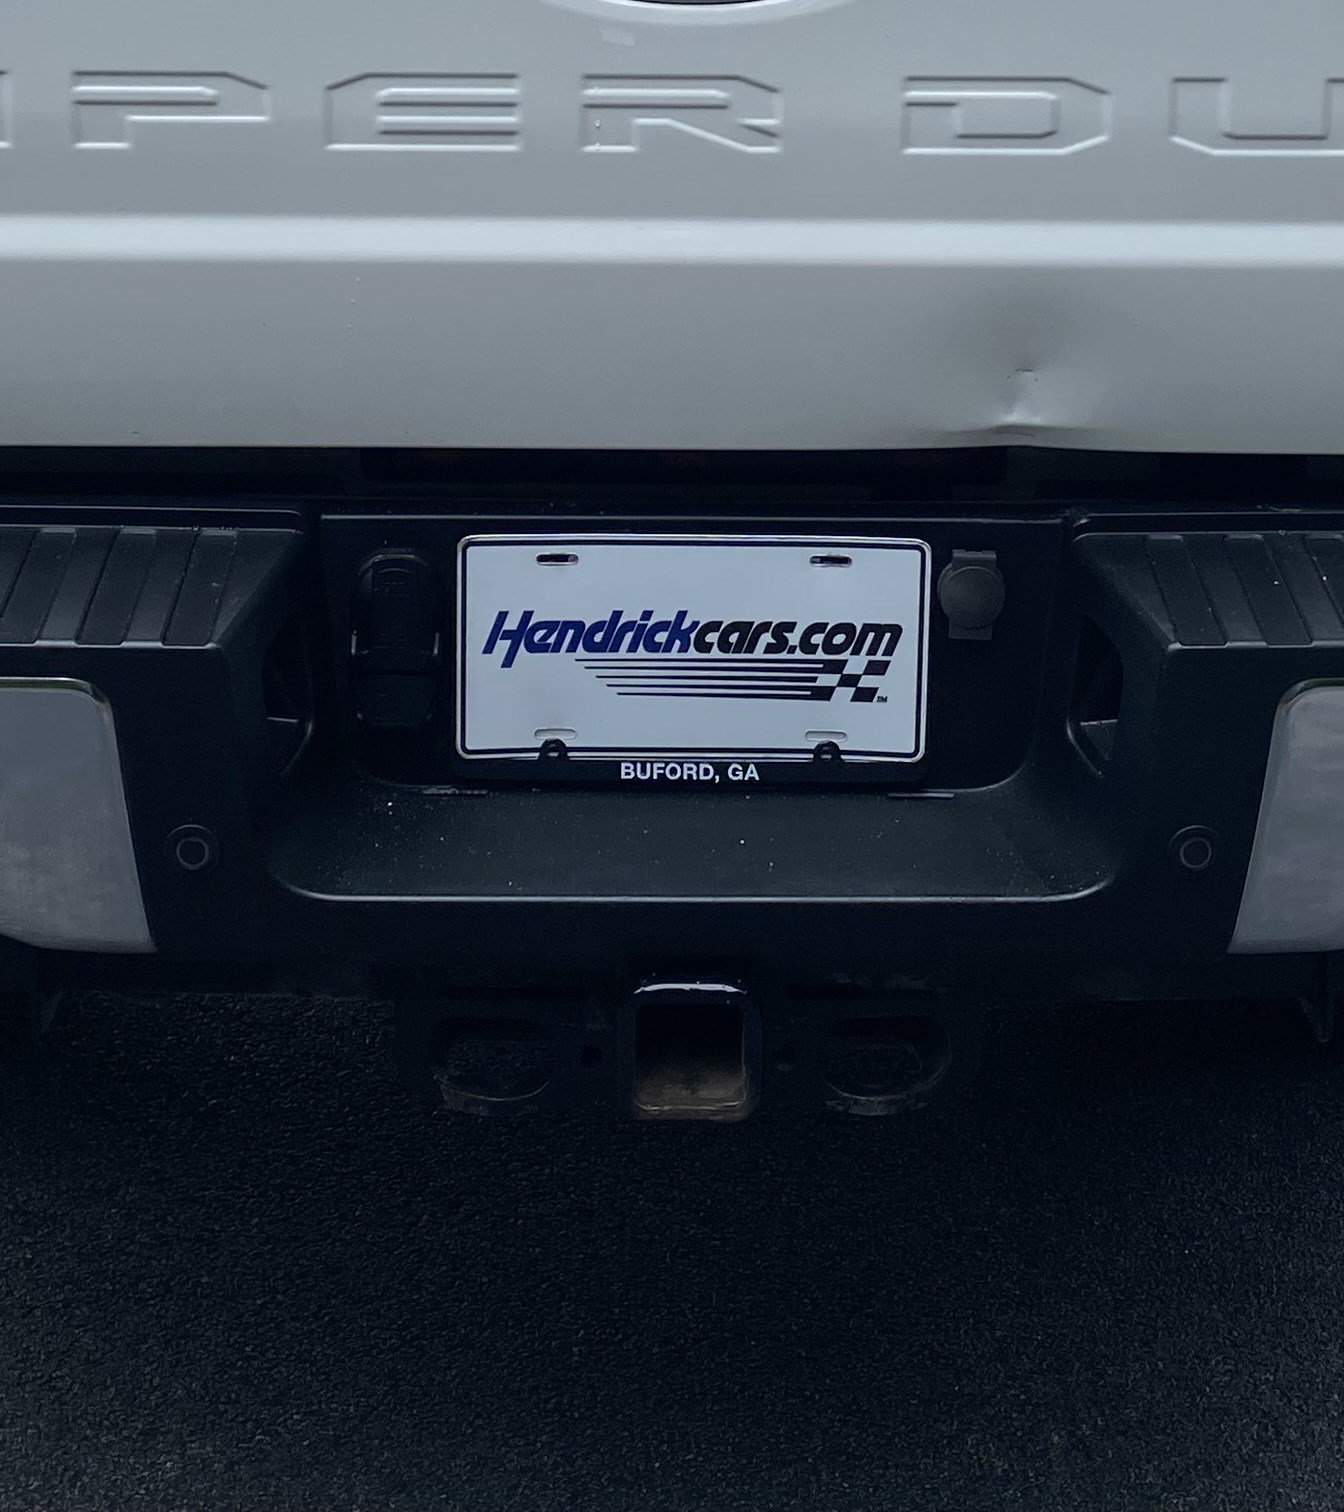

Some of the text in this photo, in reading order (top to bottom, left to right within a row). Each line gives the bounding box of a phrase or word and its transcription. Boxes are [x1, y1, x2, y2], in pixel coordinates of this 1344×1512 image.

[482, 609, 904, 669] Hendrickcars.com
[619, 762, 760, 784] BUFORD, GA
